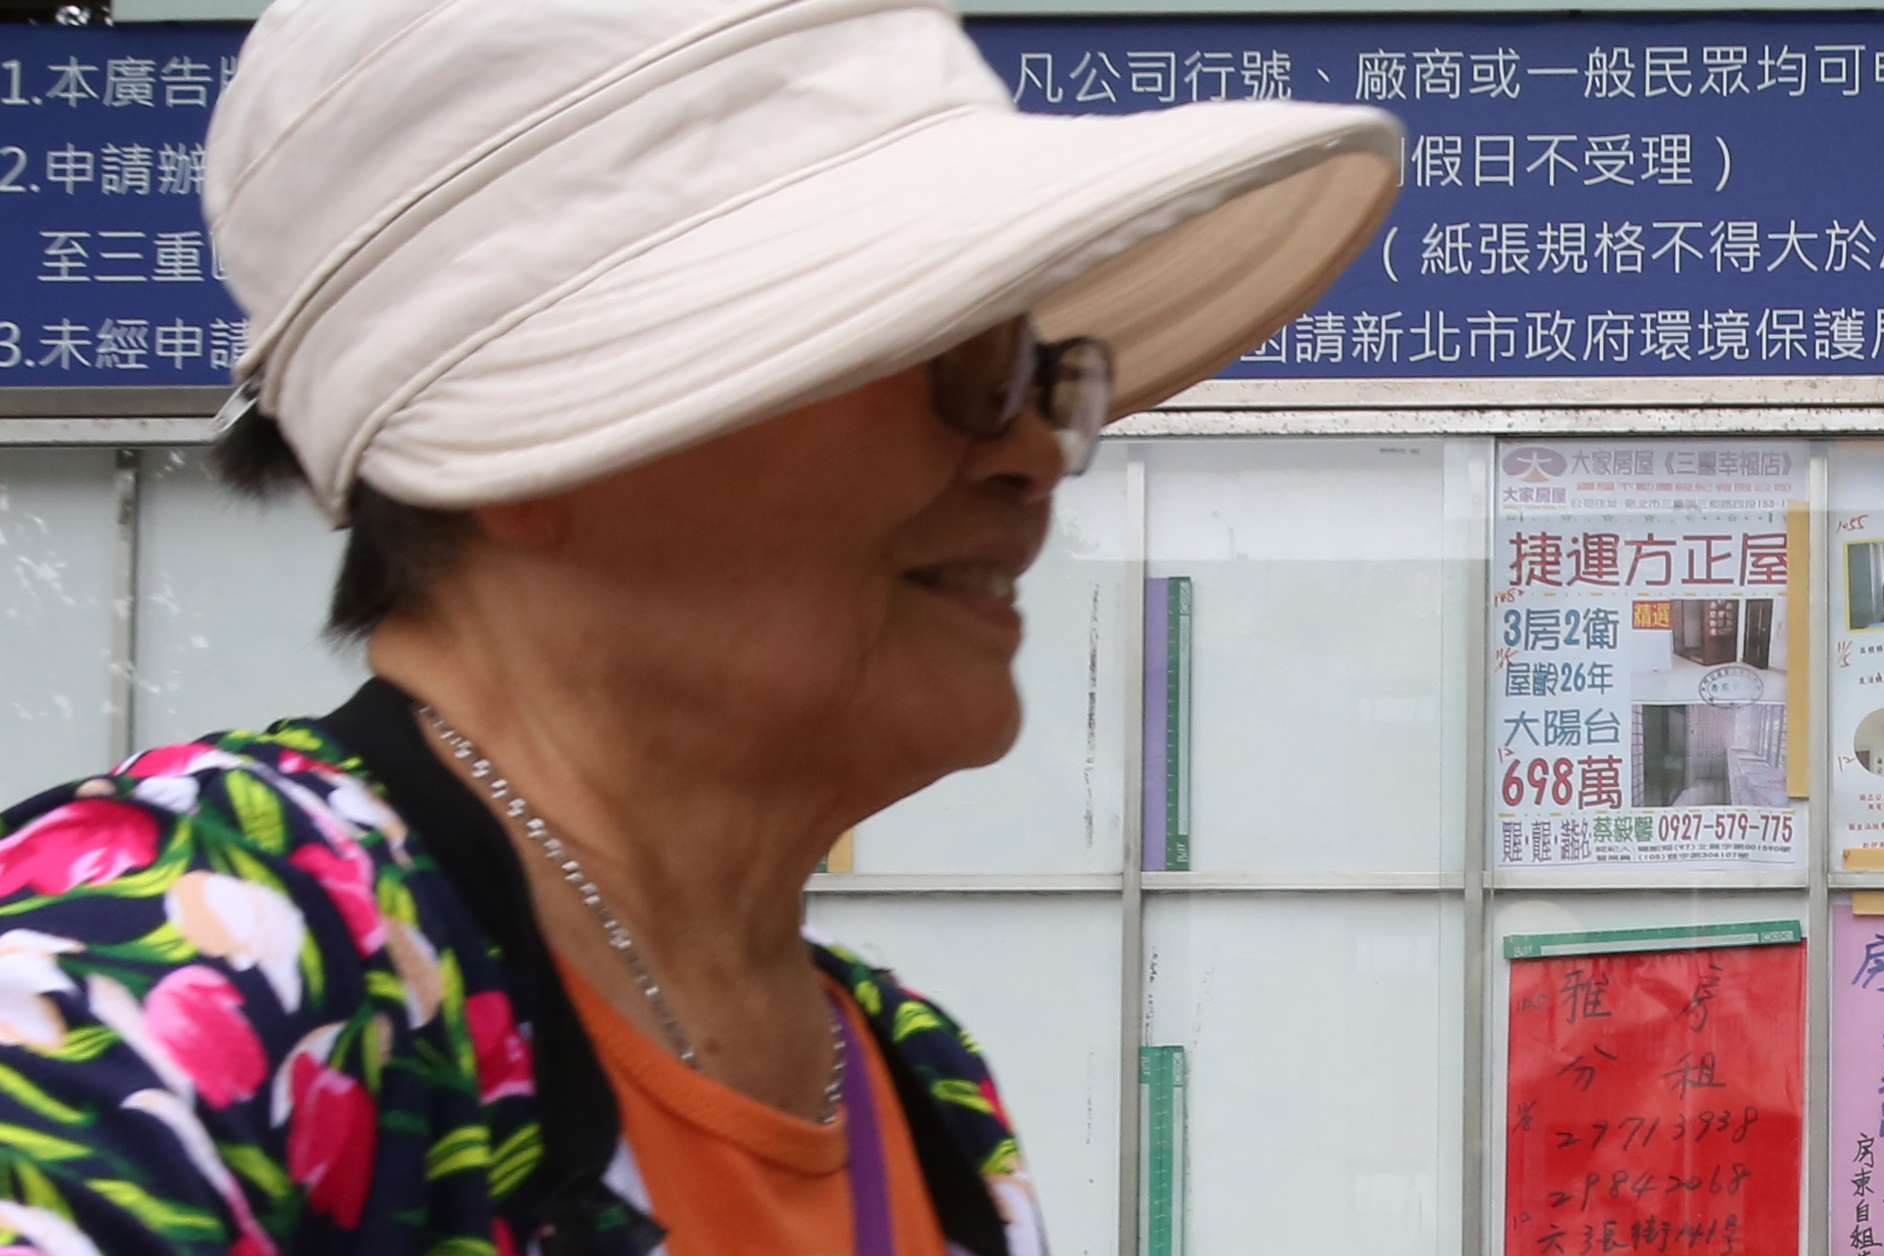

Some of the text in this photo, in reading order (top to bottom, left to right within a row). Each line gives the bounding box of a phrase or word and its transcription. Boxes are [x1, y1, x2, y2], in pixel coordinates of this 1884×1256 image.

[1394, 132, 1733, 193] 假日不受理）
[36, 228, 229, 285] 至三重
[1508, 531, 1789, 588] 捷運方正屋
[1503, 607, 1621, 651] 3房2衛
[1633, 603, 1672, 628] 精選
[1504, 661, 1614, 697] 屋齡26年
[1503, 708, 1621, 747] 大陽台
[1501, 755, 1623, 810] 698萬
[1657, 813, 1794, 843] 0927-579-775
